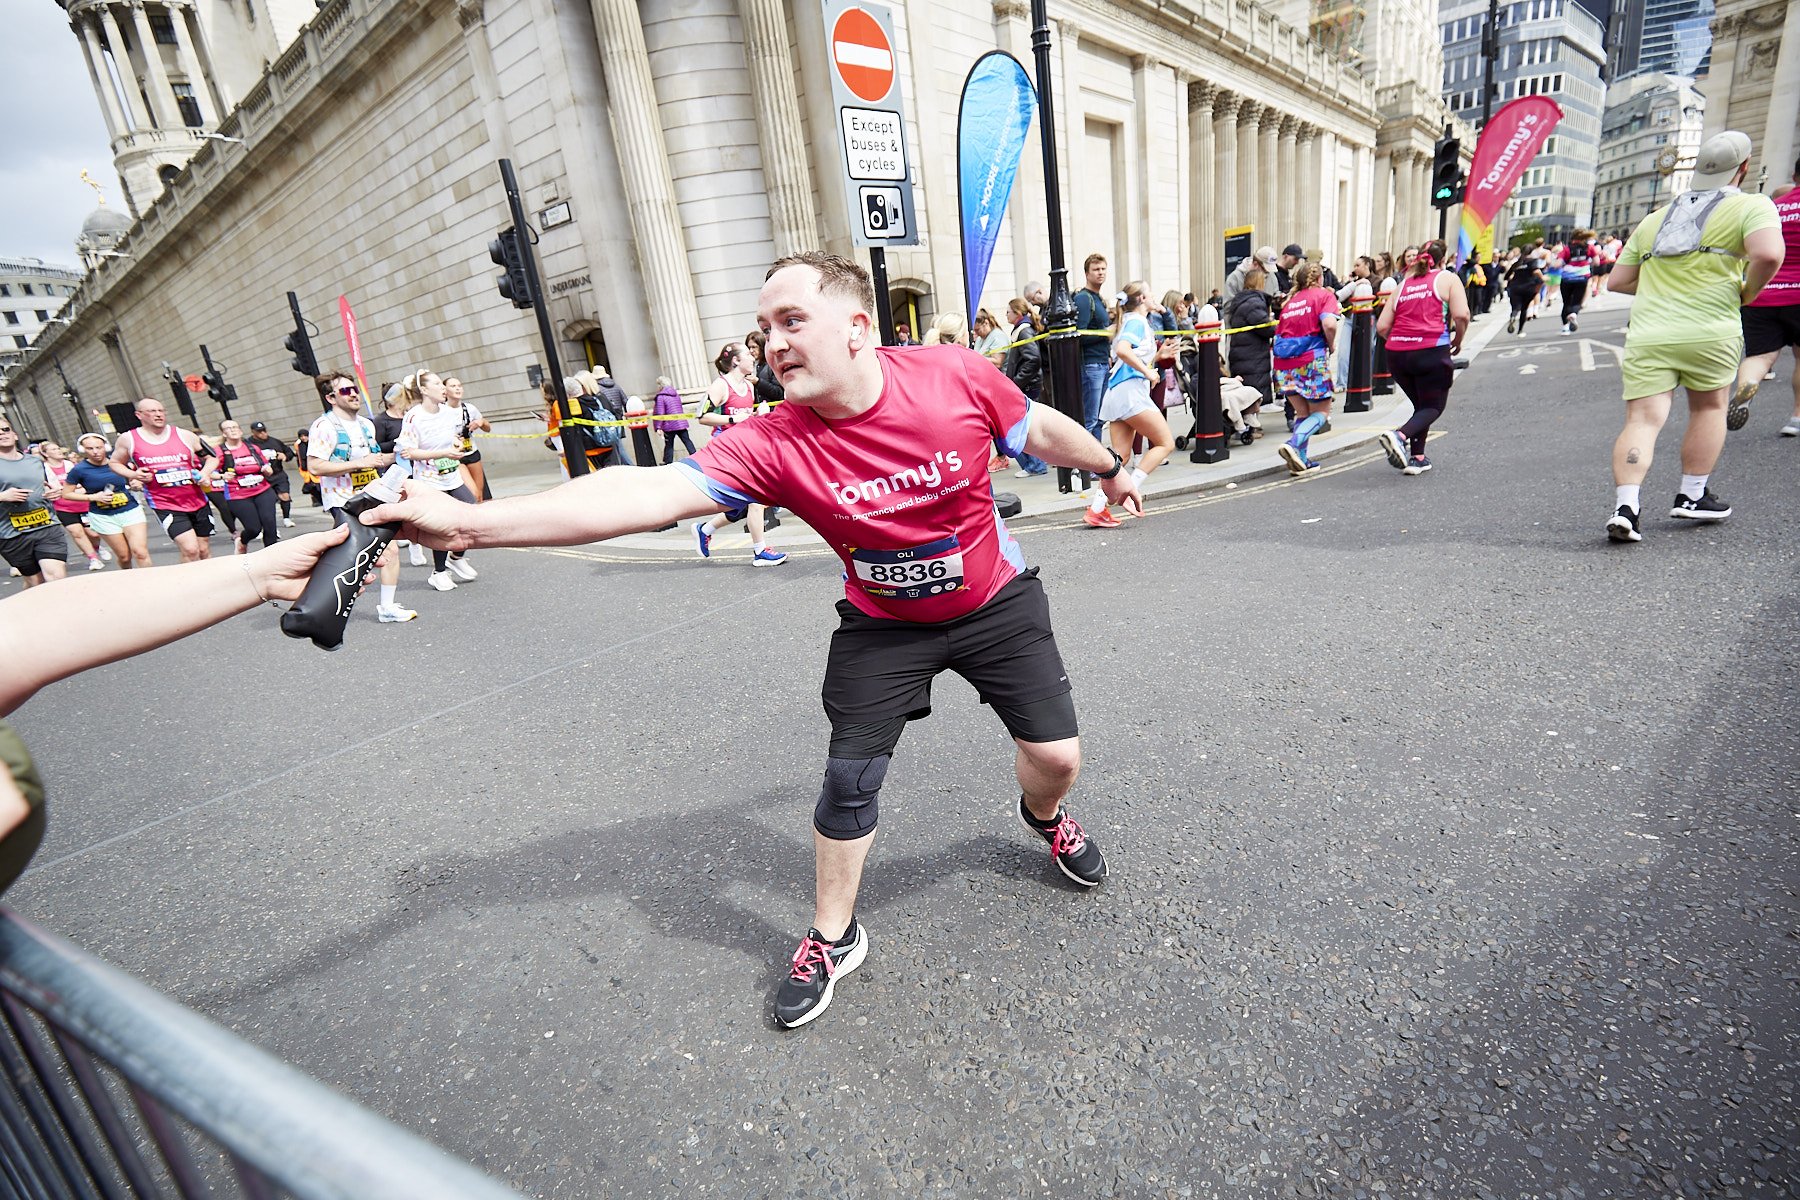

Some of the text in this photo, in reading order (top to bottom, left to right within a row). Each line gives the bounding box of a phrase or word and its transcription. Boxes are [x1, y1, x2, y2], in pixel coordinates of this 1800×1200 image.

[852, 117, 893, 135] Except
[851, 136, 898, 152] buses &
[1477, 113, 1538, 191] Tommy's
[859, 157, 896, 172] cycles
[981, 163, 999, 207] MOORE
[550, 274, 592, 294] UNDERGROUN
[1406, 284, 1427, 293] Team
[1399, 290, 1432, 303] Tommy's
[1288, 300, 1306, 309] Team
[1281, 306, 1312, 320] Tommy's
[138, 454, 188, 465] Tommy's
[354, 471, 378, 484] 1216
[826, 450, 963, 505] Tommy's
[833, 513, 850, 521] The
[896, 498, 914, 511] and
[915, 491, 939, 504] baby
[940, 477, 970, 497] charity
[15, 511, 47, 525] 14408
[897, 551, 914, 559] OLI
[870, 560, 947, 584] 8836
